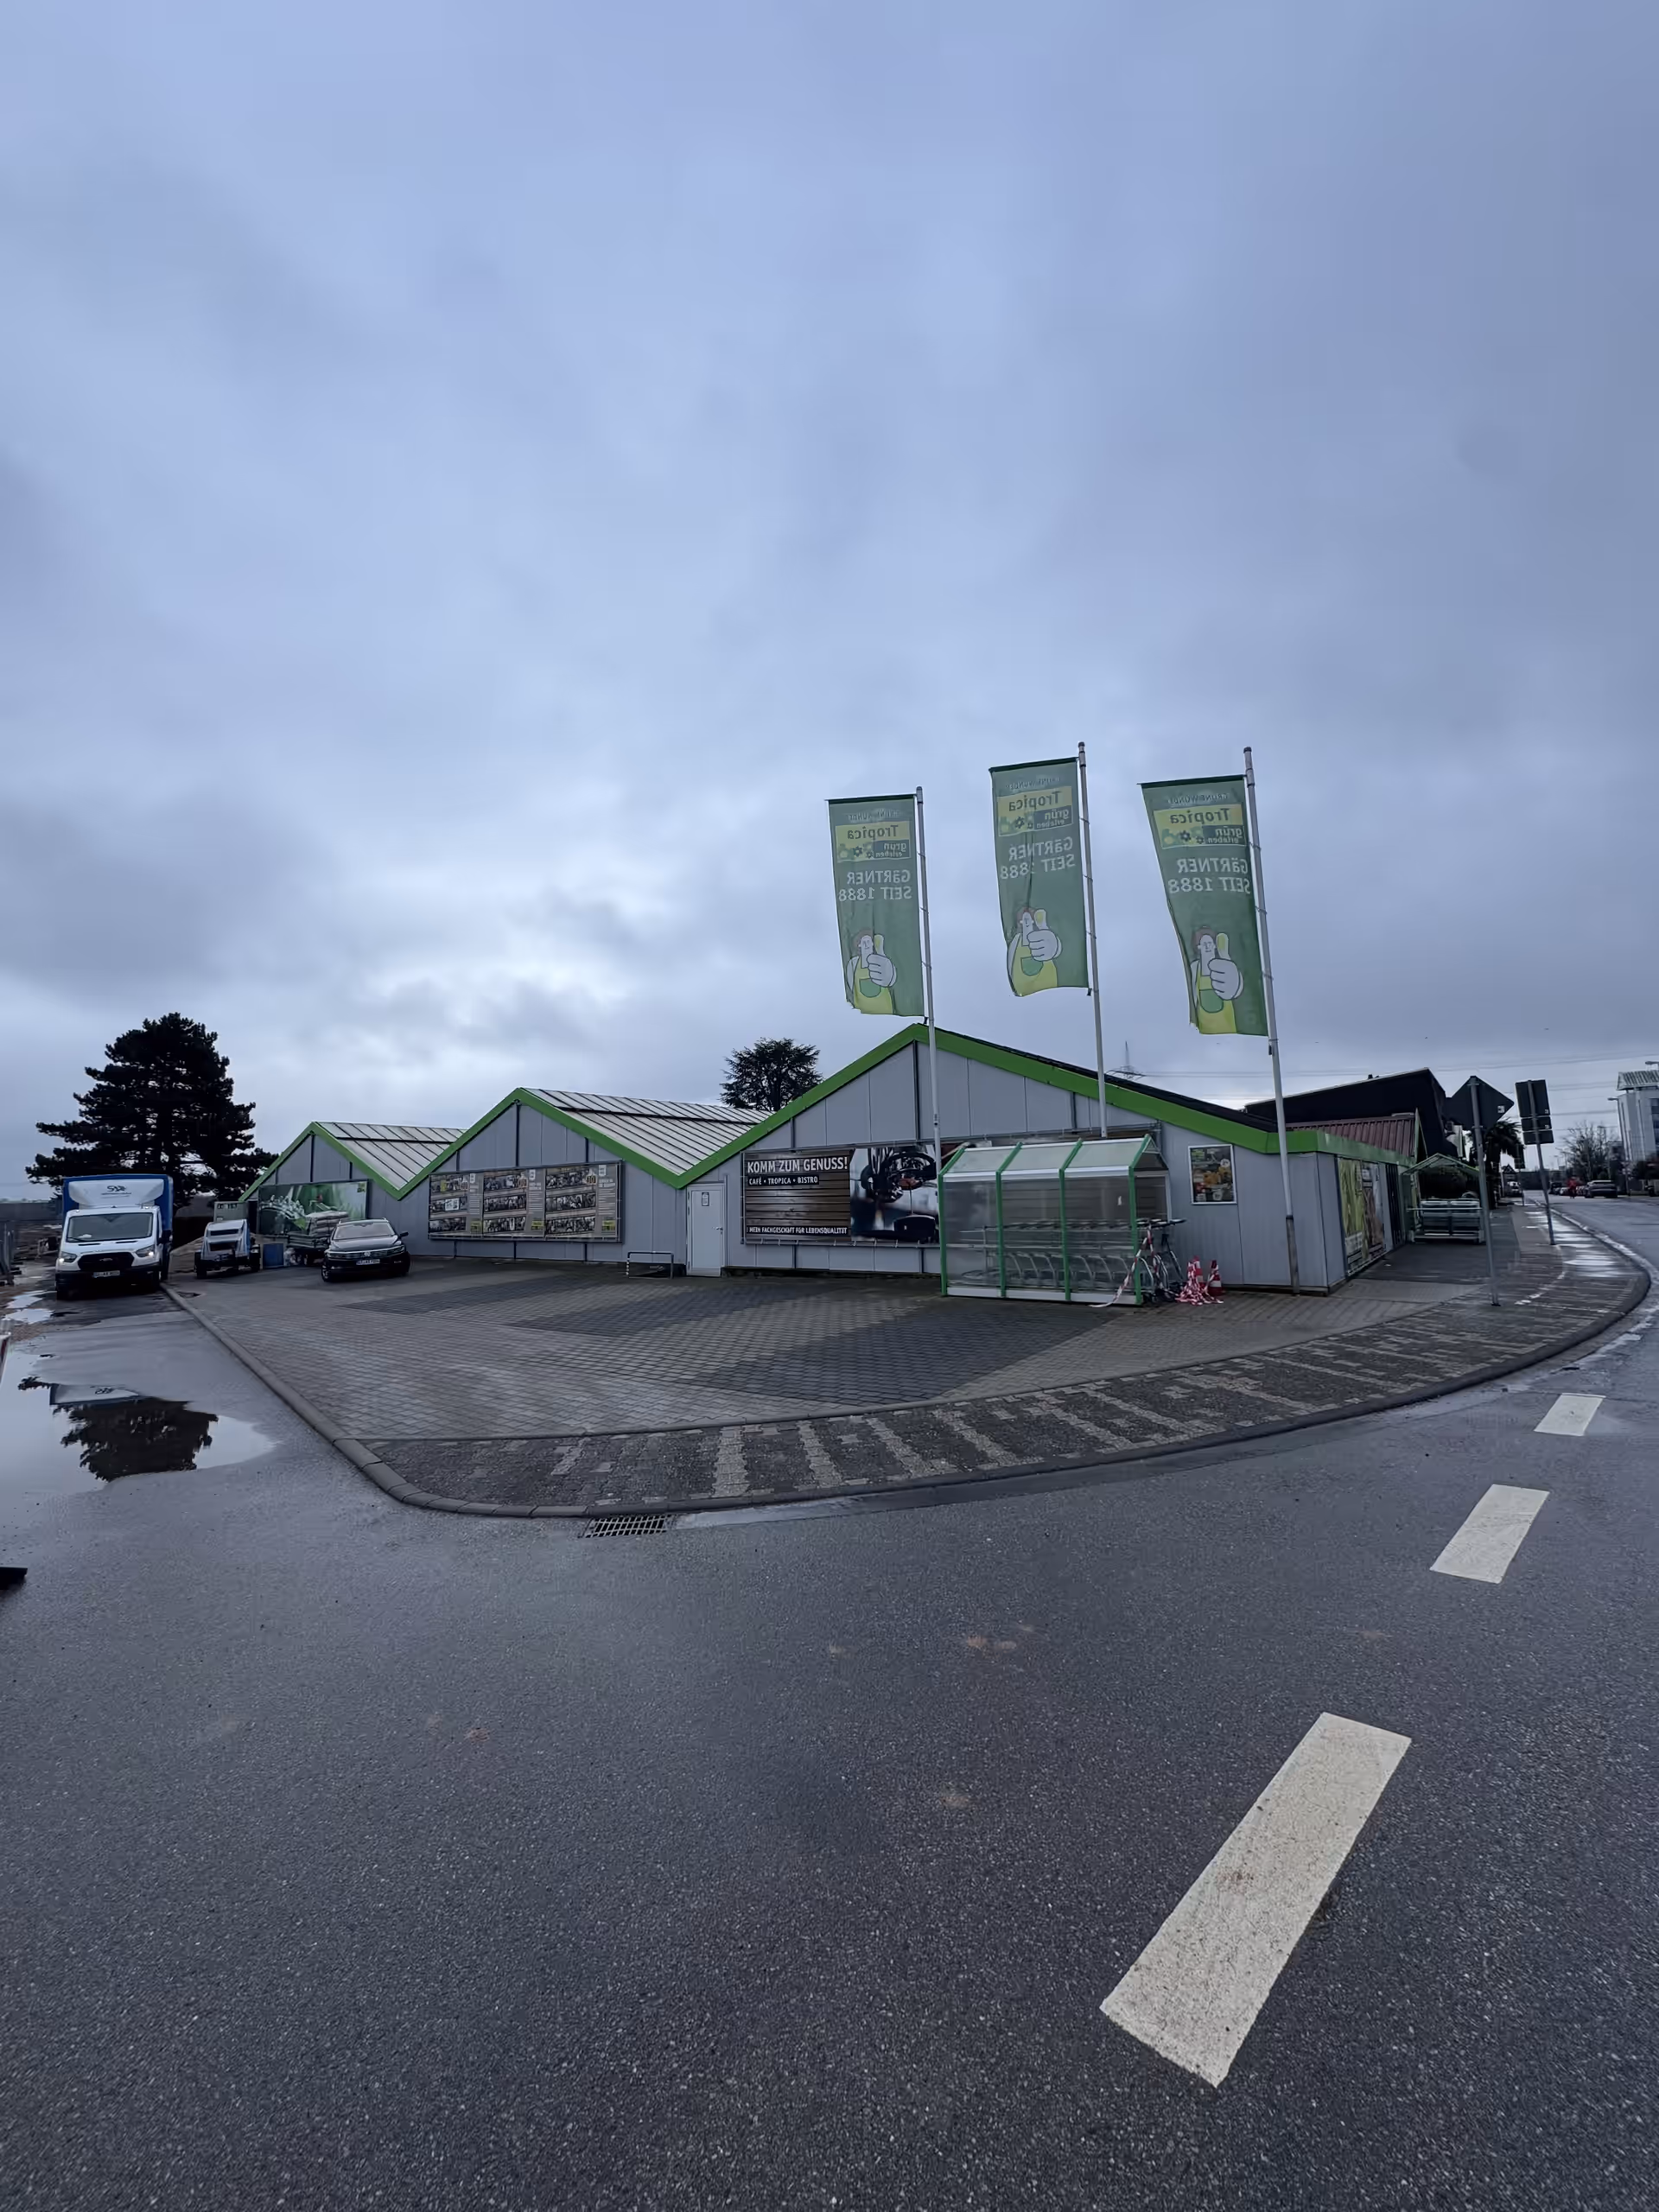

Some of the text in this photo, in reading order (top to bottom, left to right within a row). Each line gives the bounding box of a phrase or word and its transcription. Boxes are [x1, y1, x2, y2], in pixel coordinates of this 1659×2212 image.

[747, 1156, 848, 1173] KOMM ZUM GENUSS!
[749, 1177, 762, 1185] CAFÉ
